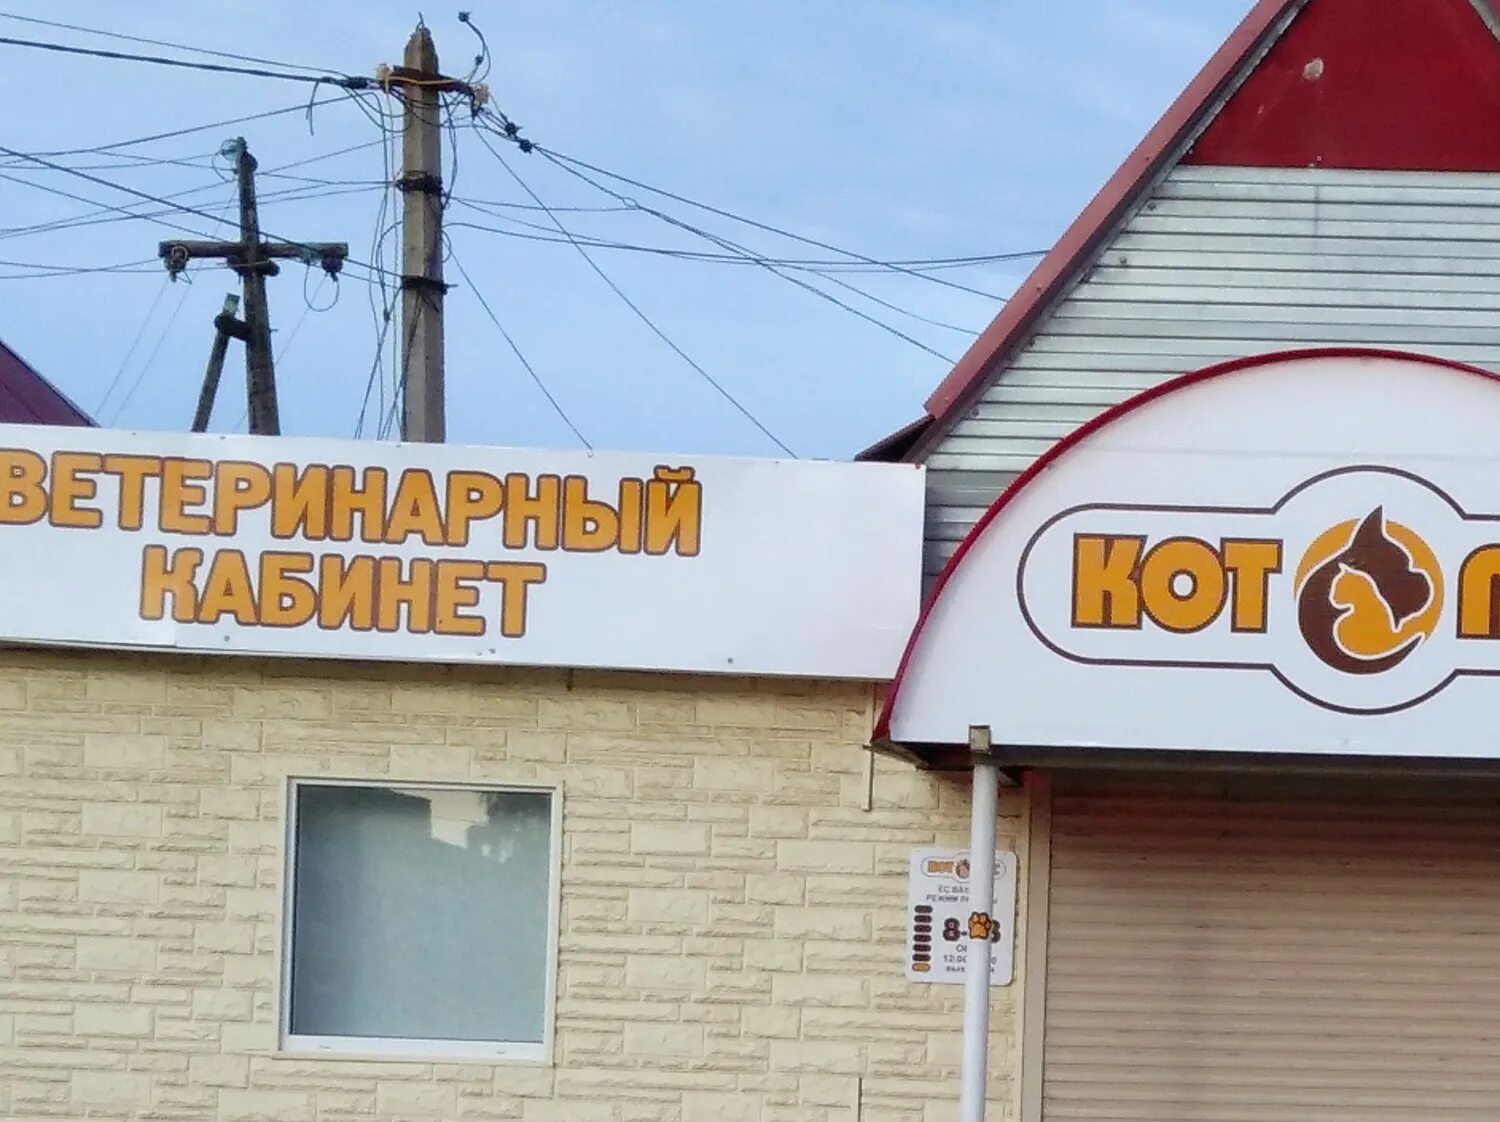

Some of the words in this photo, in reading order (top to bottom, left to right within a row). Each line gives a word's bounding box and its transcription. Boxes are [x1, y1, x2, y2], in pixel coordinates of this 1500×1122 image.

[0, 447, 701, 557] ВЕТЕРИНАРНЫЙ
[139, 544, 547, 638] КАБИНЕТ
[1071, 533, 1284, 634] КОТ
